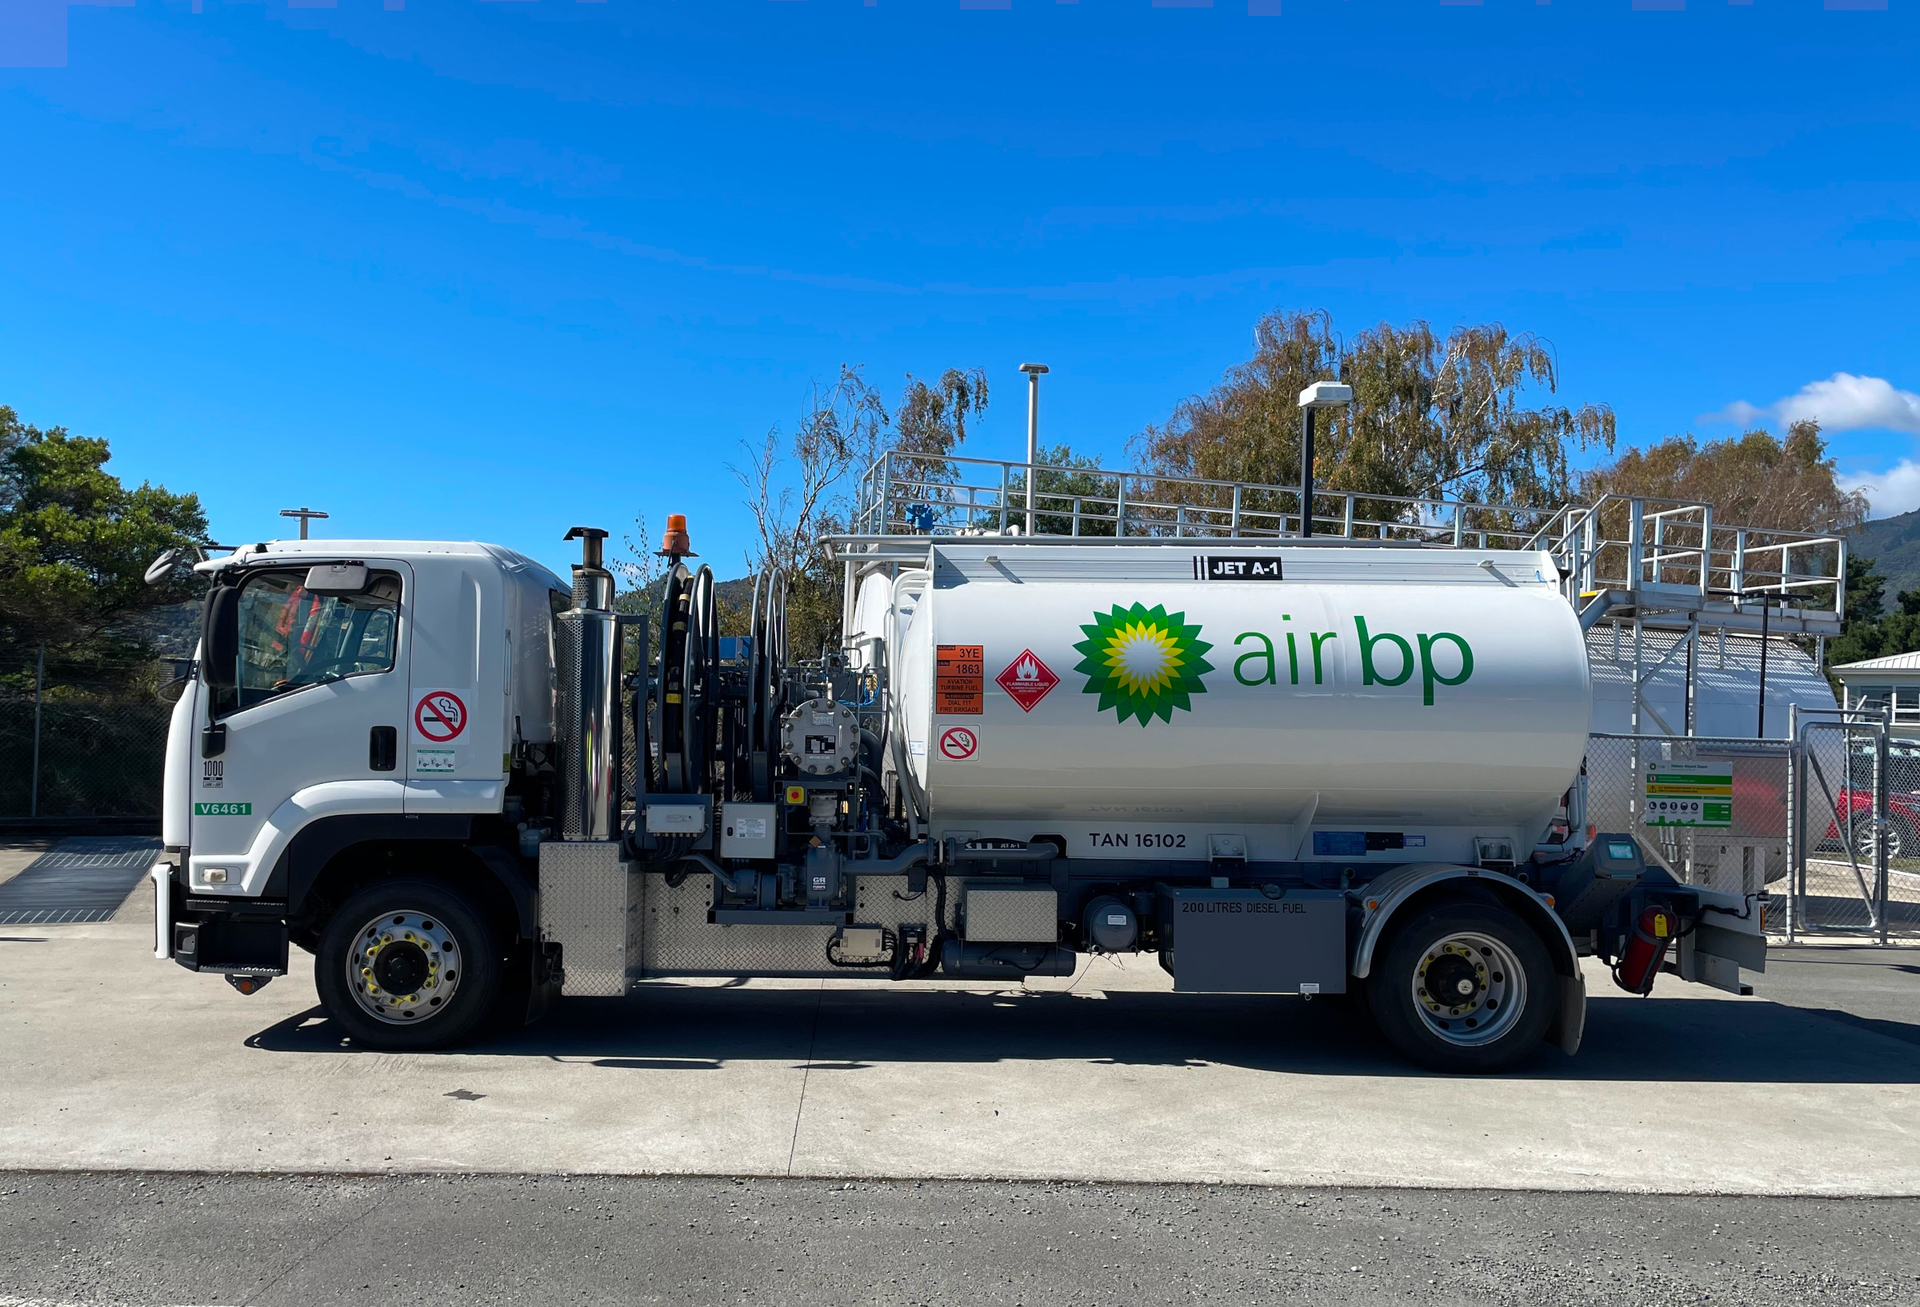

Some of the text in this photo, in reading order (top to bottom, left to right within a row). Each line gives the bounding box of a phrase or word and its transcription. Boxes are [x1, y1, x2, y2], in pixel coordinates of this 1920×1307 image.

[1213, 562, 1278, 575] JET A-1
[960, 648, 980, 658] 3YE
[1233, 614, 1474, 706] air bp
[956, 664, 980, 674] 1863
[203, 760, 223, 776] 1000
[200, 804, 246, 814] V6461
[1089, 833, 1186, 848] TAN 16102
[1182, 902, 1306, 914] 200 LITRES DIESEL FUEL
